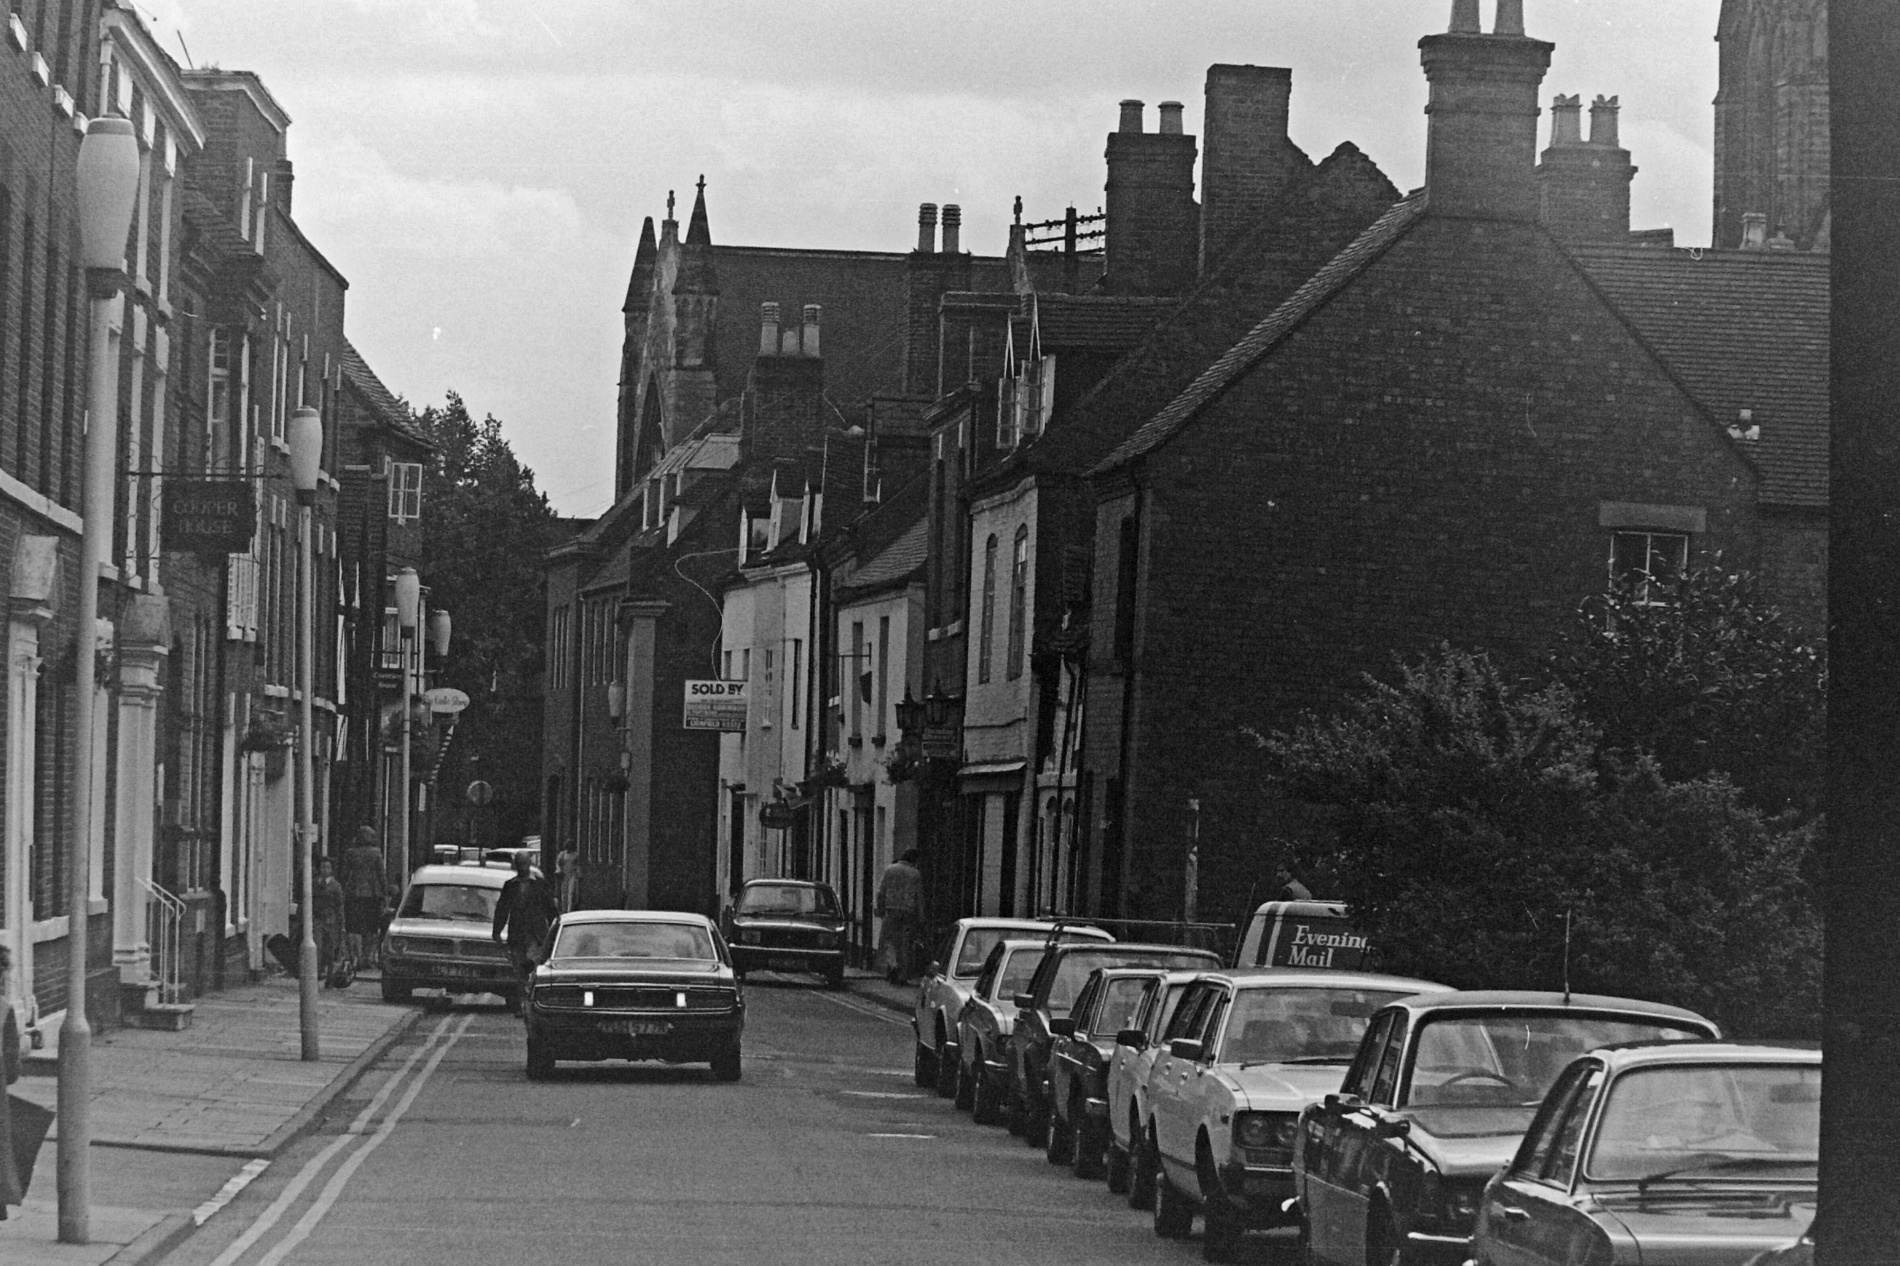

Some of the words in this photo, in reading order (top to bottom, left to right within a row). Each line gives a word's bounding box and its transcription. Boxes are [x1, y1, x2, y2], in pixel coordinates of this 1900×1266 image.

[691, 683, 726, 695] SOLD
[728, 683, 744, 695] BY
[1287, 945, 1334, 967] Mail
